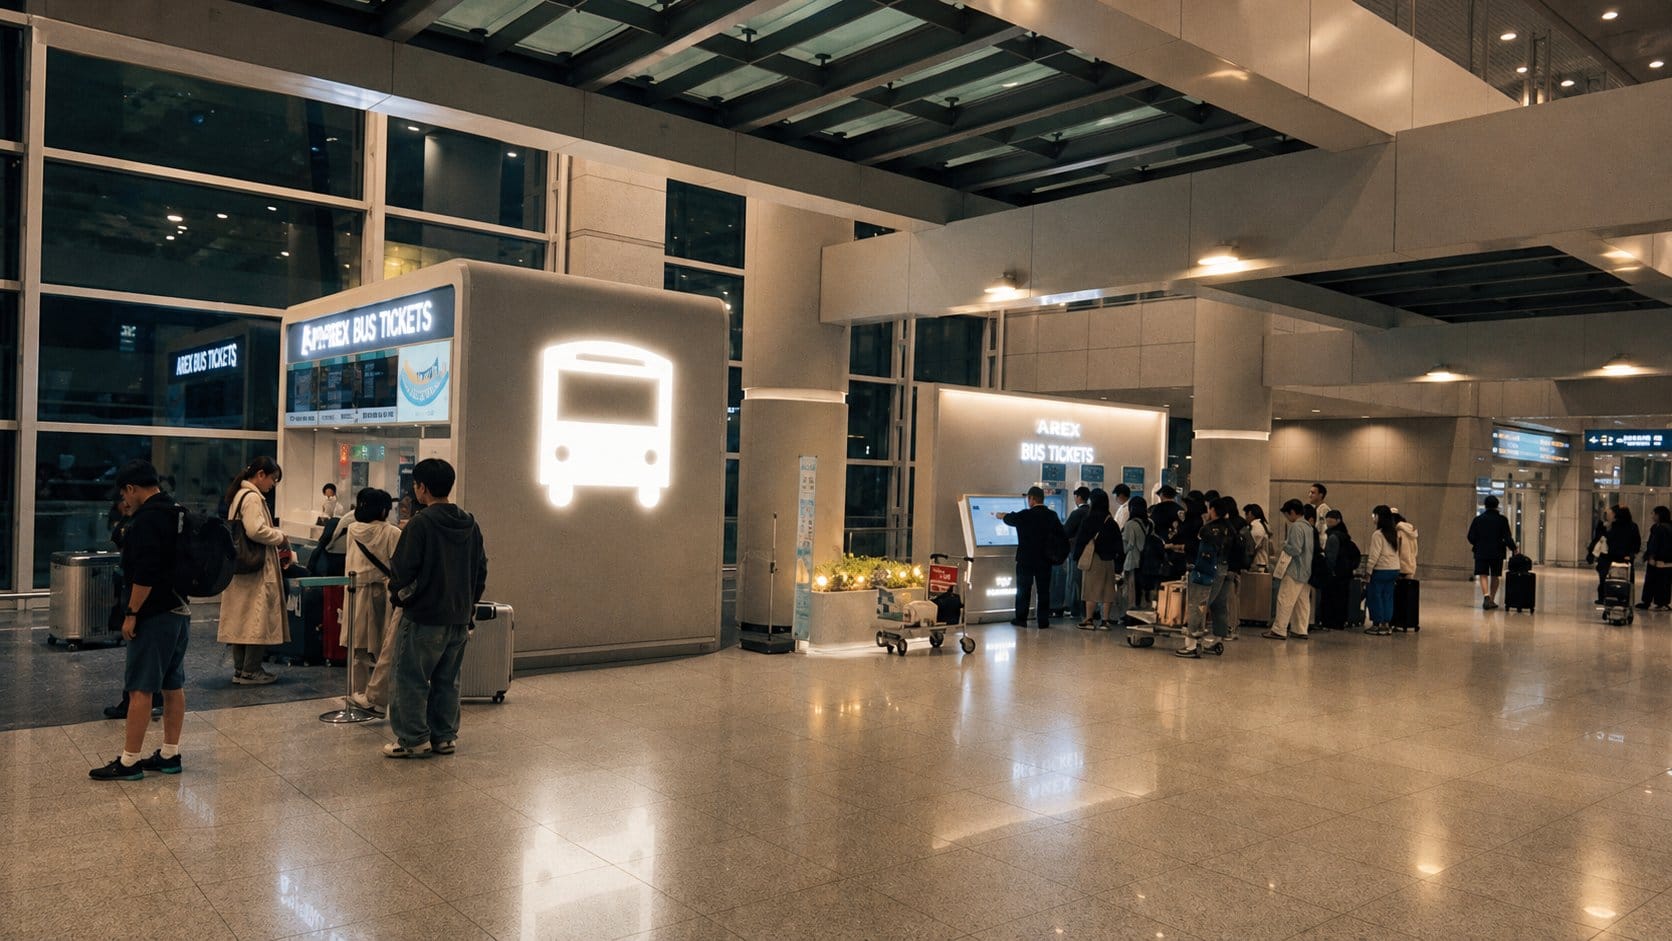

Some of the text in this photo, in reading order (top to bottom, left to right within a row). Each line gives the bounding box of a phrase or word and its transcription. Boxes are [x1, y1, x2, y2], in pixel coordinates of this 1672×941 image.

[353, 313, 377, 344] BUS
[379, 300, 433, 338] TICKETS
[176, 343, 237, 376] AREX BUS TICKETS
[1036, 419, 1081, 437] AREX
[1020, 442, 1094, 463] BUS TICKETS
